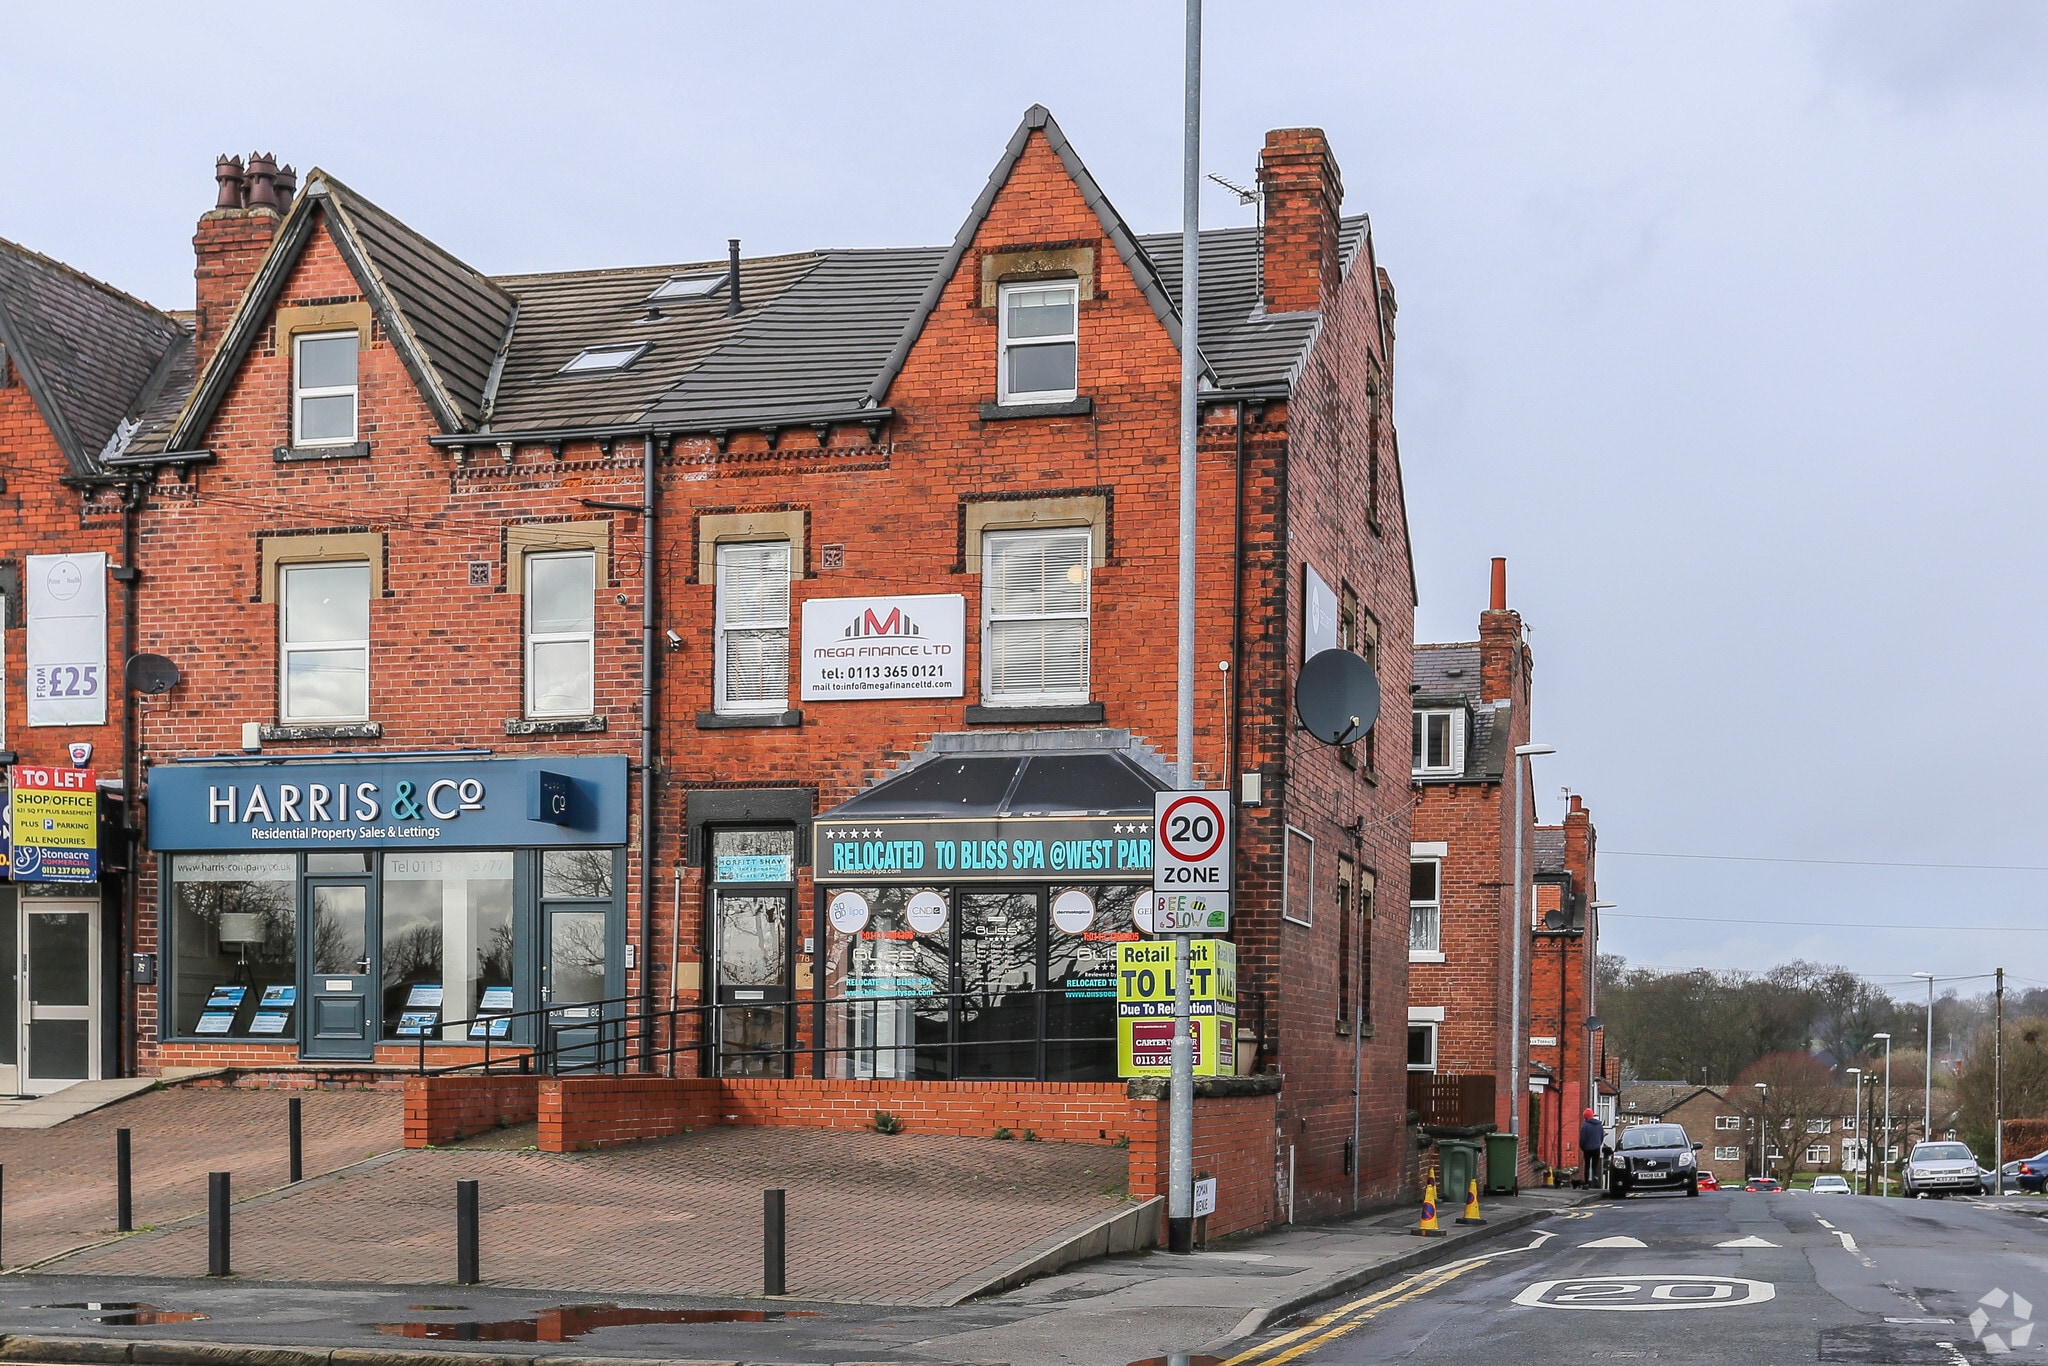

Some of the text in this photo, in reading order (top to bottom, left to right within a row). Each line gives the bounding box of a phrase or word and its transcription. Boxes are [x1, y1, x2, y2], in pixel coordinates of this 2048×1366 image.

[814, 644, 952, 658] MEGA FINANCE LTD
[821, 664, 944, 680] tel: 0113 365 0121
[37, 666, 98, 698] FROM £25
[812, 681, 952, 691] mail to:info@megafinanceltd.com
[22, 770, 87, 788] TO LET
[16, 794, 93, 807] SHOP/OFFICE
[209, 783, 380, 823] HARRIS
[20, 820, 39, 828] PLUS
[57, 822, 89, 830] PARKING
[1171, 816, 1213, 842] 20
[25, 836, 86, 845] ALL ENQUIRIES
[251, 826, 440, 841] Residential Property Sales & Lettings
[41, 848, 89, 860] Stoneacre
[833, 839, 1154, 871] RELOCATED TO BLISS SPA @WEST PAR
[41, 866, 57, 874] 0113
[71, 867, 91, 875] 0999
[391, 860, 410, 873] Tel
[1164, 867, 1220, 883] ZONE
[1158, 896, 1187, 911] BEE
[1166, 912, 1203, 929] SLOW
[800, 954, 810, 962] 78
[1124, 946, 1170, 962] Retail
[897, 978, 916, 986] BLISS
[1066, 980, 1107, 988] RELOCATED
[1121, 969, 1156, 997] TO
[1120, 1003, 1140, 1015] Due
[1142, 1003, 1155, 1014] To
[1554, 1284, 1733, 1301] 20
